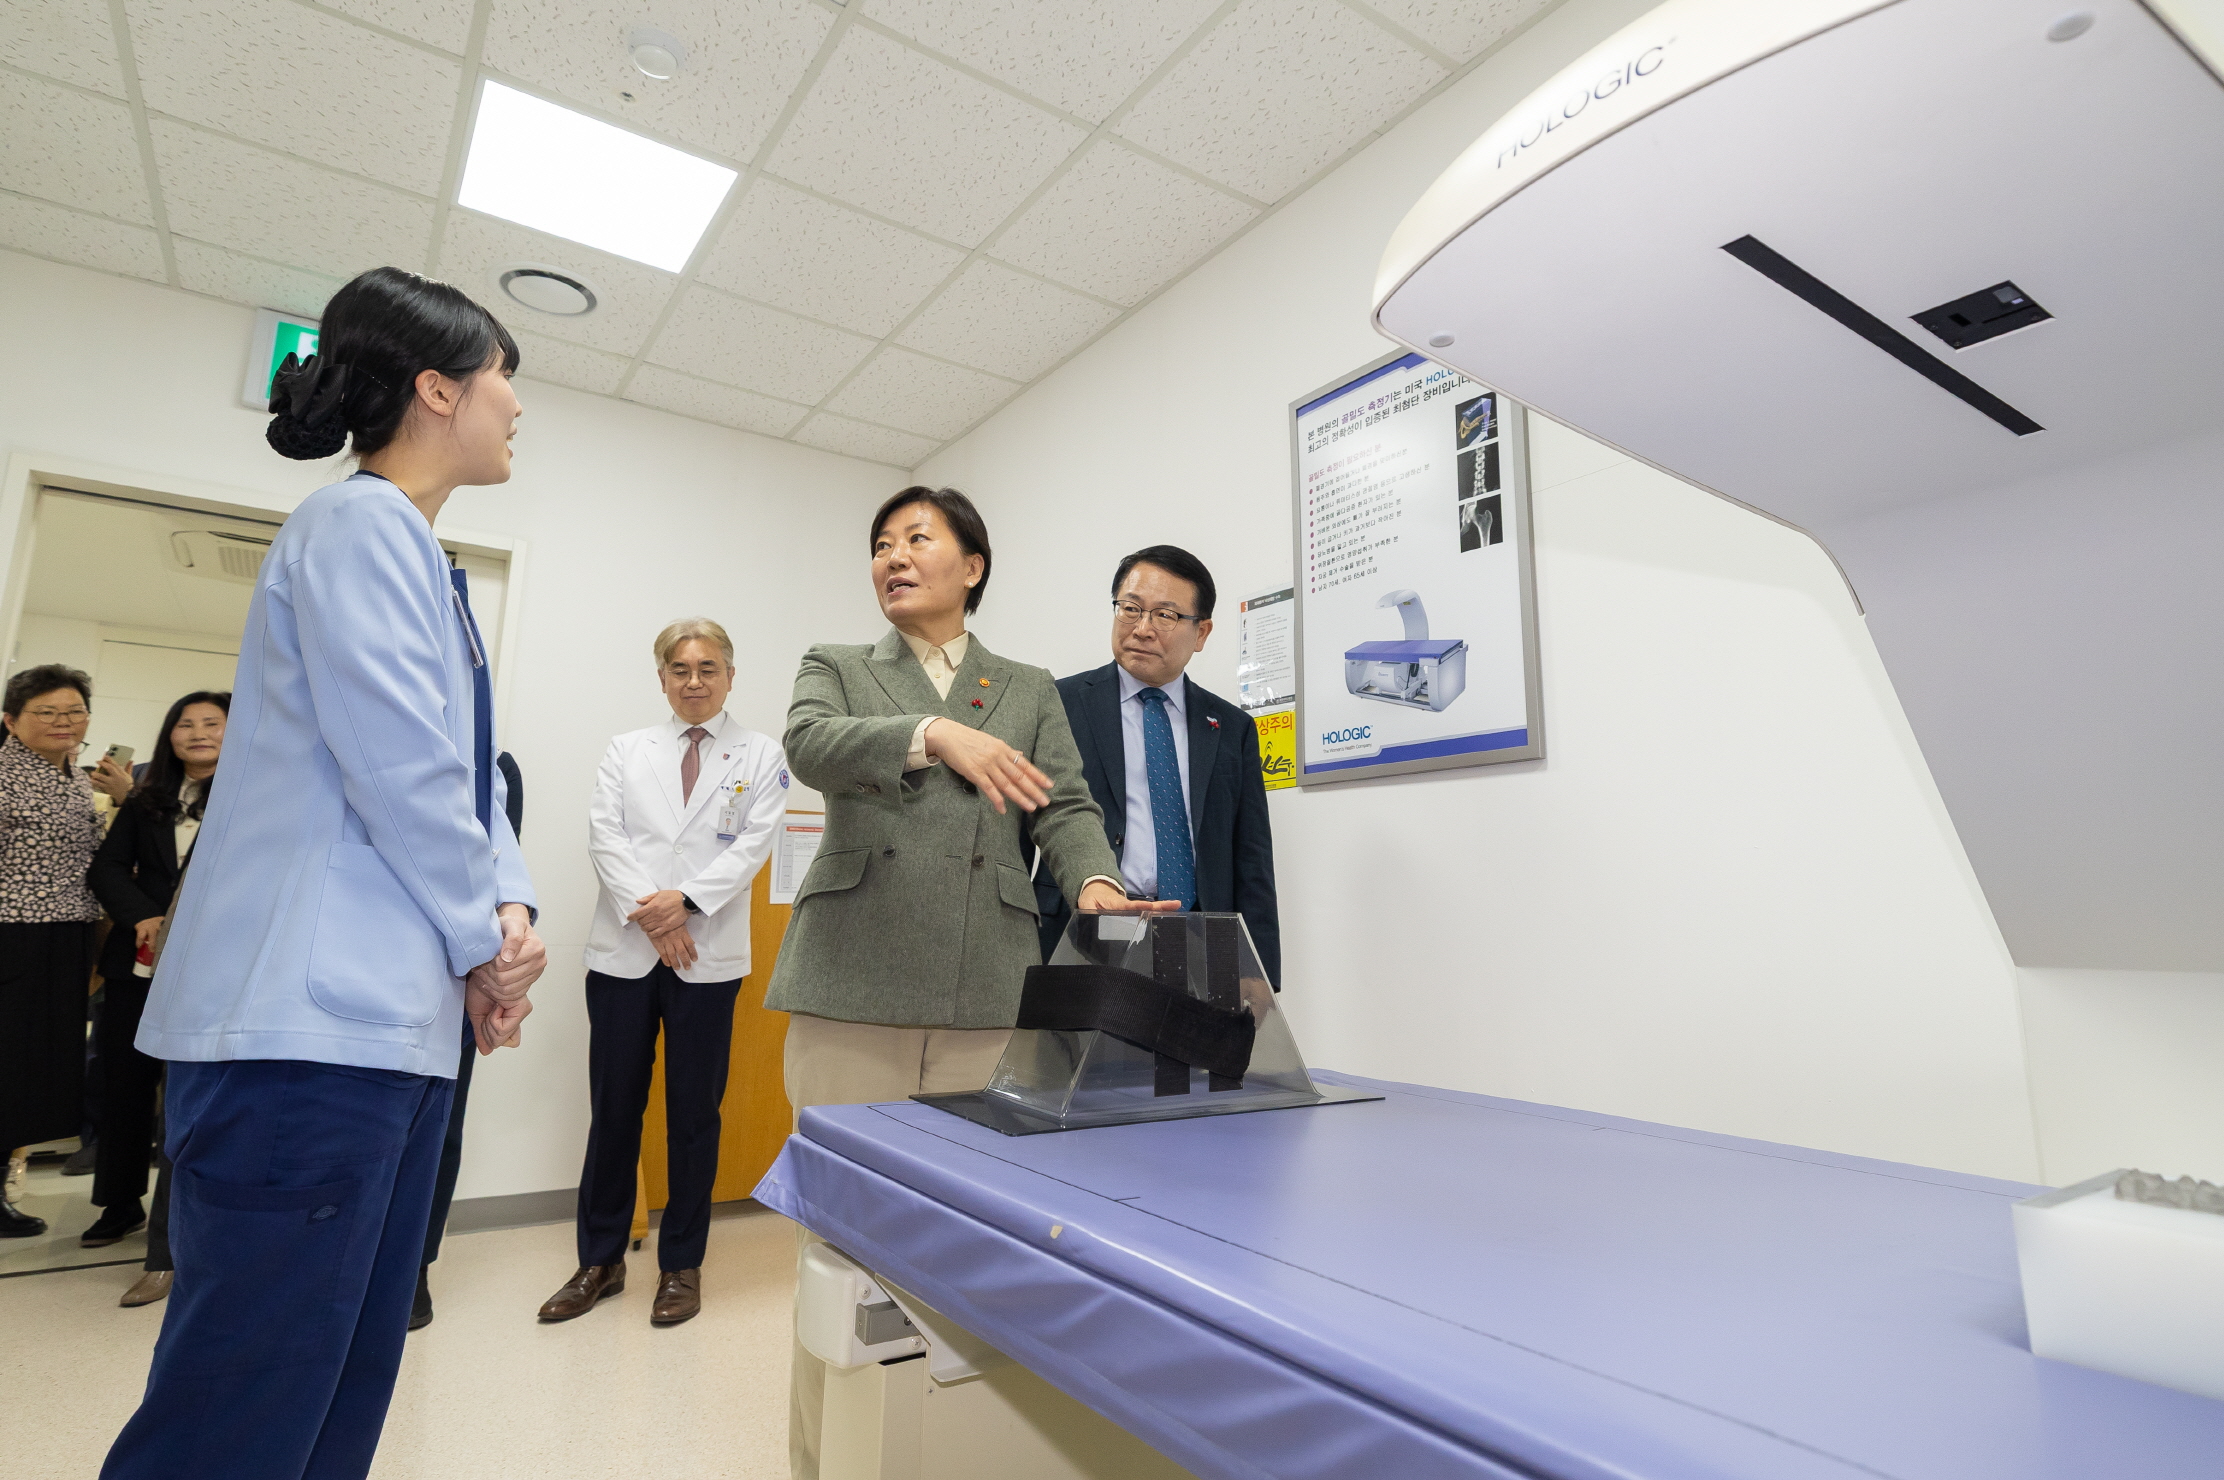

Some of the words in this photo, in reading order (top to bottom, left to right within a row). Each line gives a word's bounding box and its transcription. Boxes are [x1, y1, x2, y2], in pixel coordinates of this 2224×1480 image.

[1497, 46, 1664, 169] HOLOGIC
[1307, 435, 1329, 454] 최고의
[1332, 419, 1362, 443] 정확성이
[1365, 407, 1390, 427] 입증된
[1393, 394, 1419, 414] 최첨단
[1308, 430, 1315, 441] 본
[1317, 417, 1339, 437] 병원의
[1341, 405, 1365, 425] 골밀도
[1367, 390, 1402, 411] 측정기는
[1404, 379, 1423, 394] 미국
[1308, 468, 1326, 483] 골밀도
[1327, 458, 1345, 473] 측정이
[1322, 725, 1371, 745] HOLOGIC
